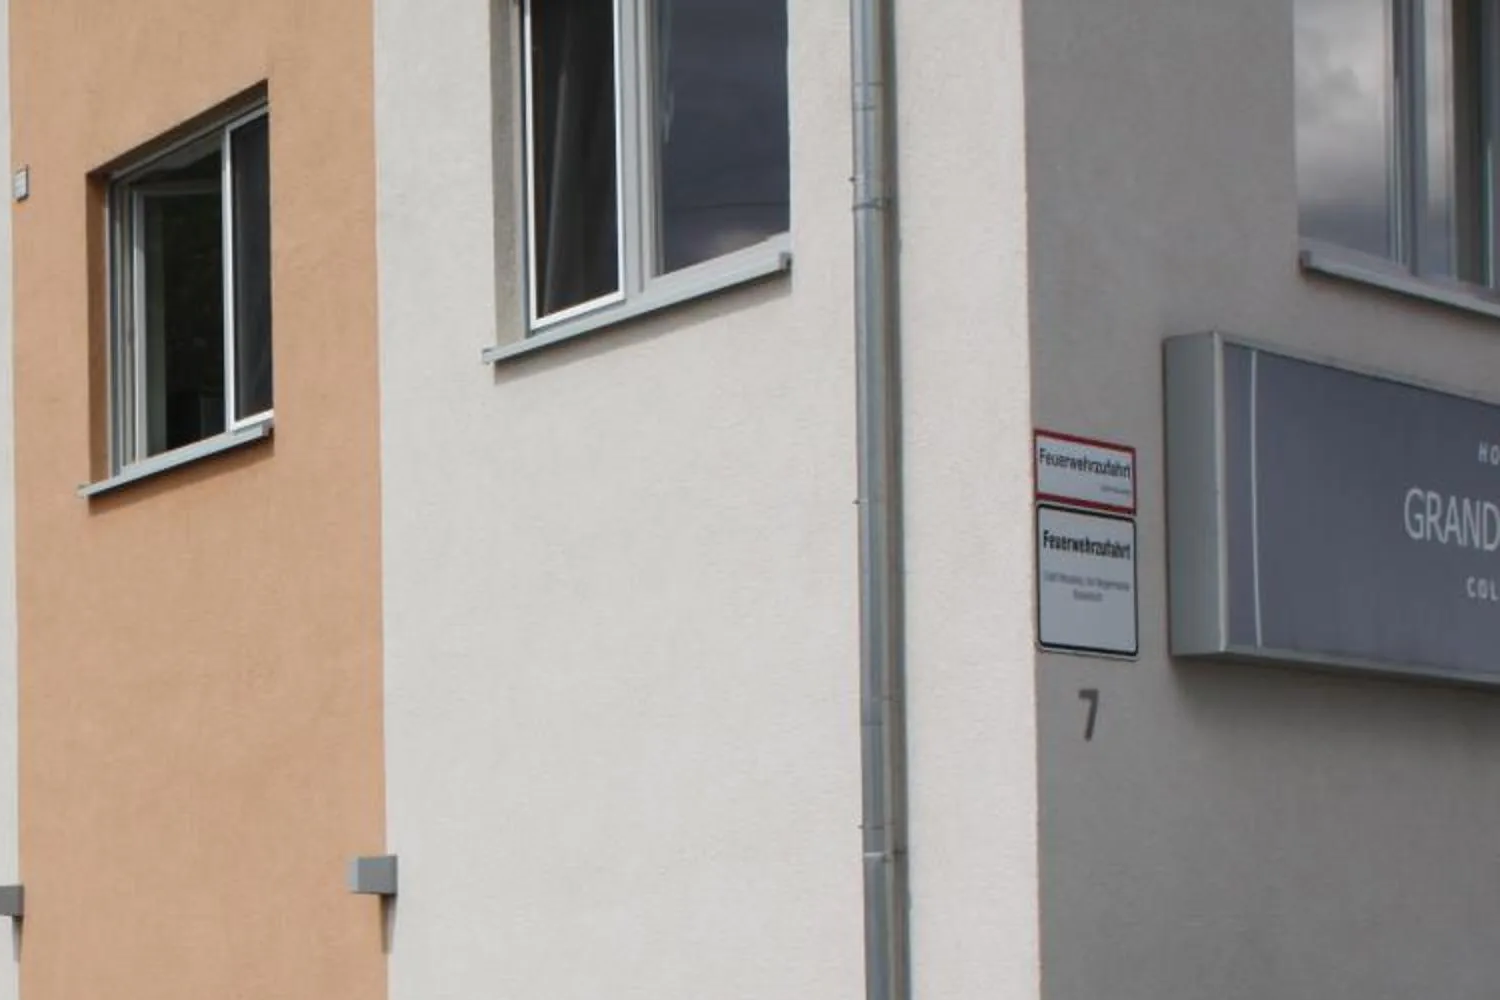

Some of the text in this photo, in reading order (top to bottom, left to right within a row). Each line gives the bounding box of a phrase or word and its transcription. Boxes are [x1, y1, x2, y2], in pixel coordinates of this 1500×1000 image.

[1039, 447, 1131, 480] Feuerwehrzufahrt
[1404, 487, 1500, 552] GRAND
[1042, 529, 1131, 561] Feuerwehrzufahrt
[1466, 576, 1500, 602] COL
[1078, 688, 1099, 741] 7
